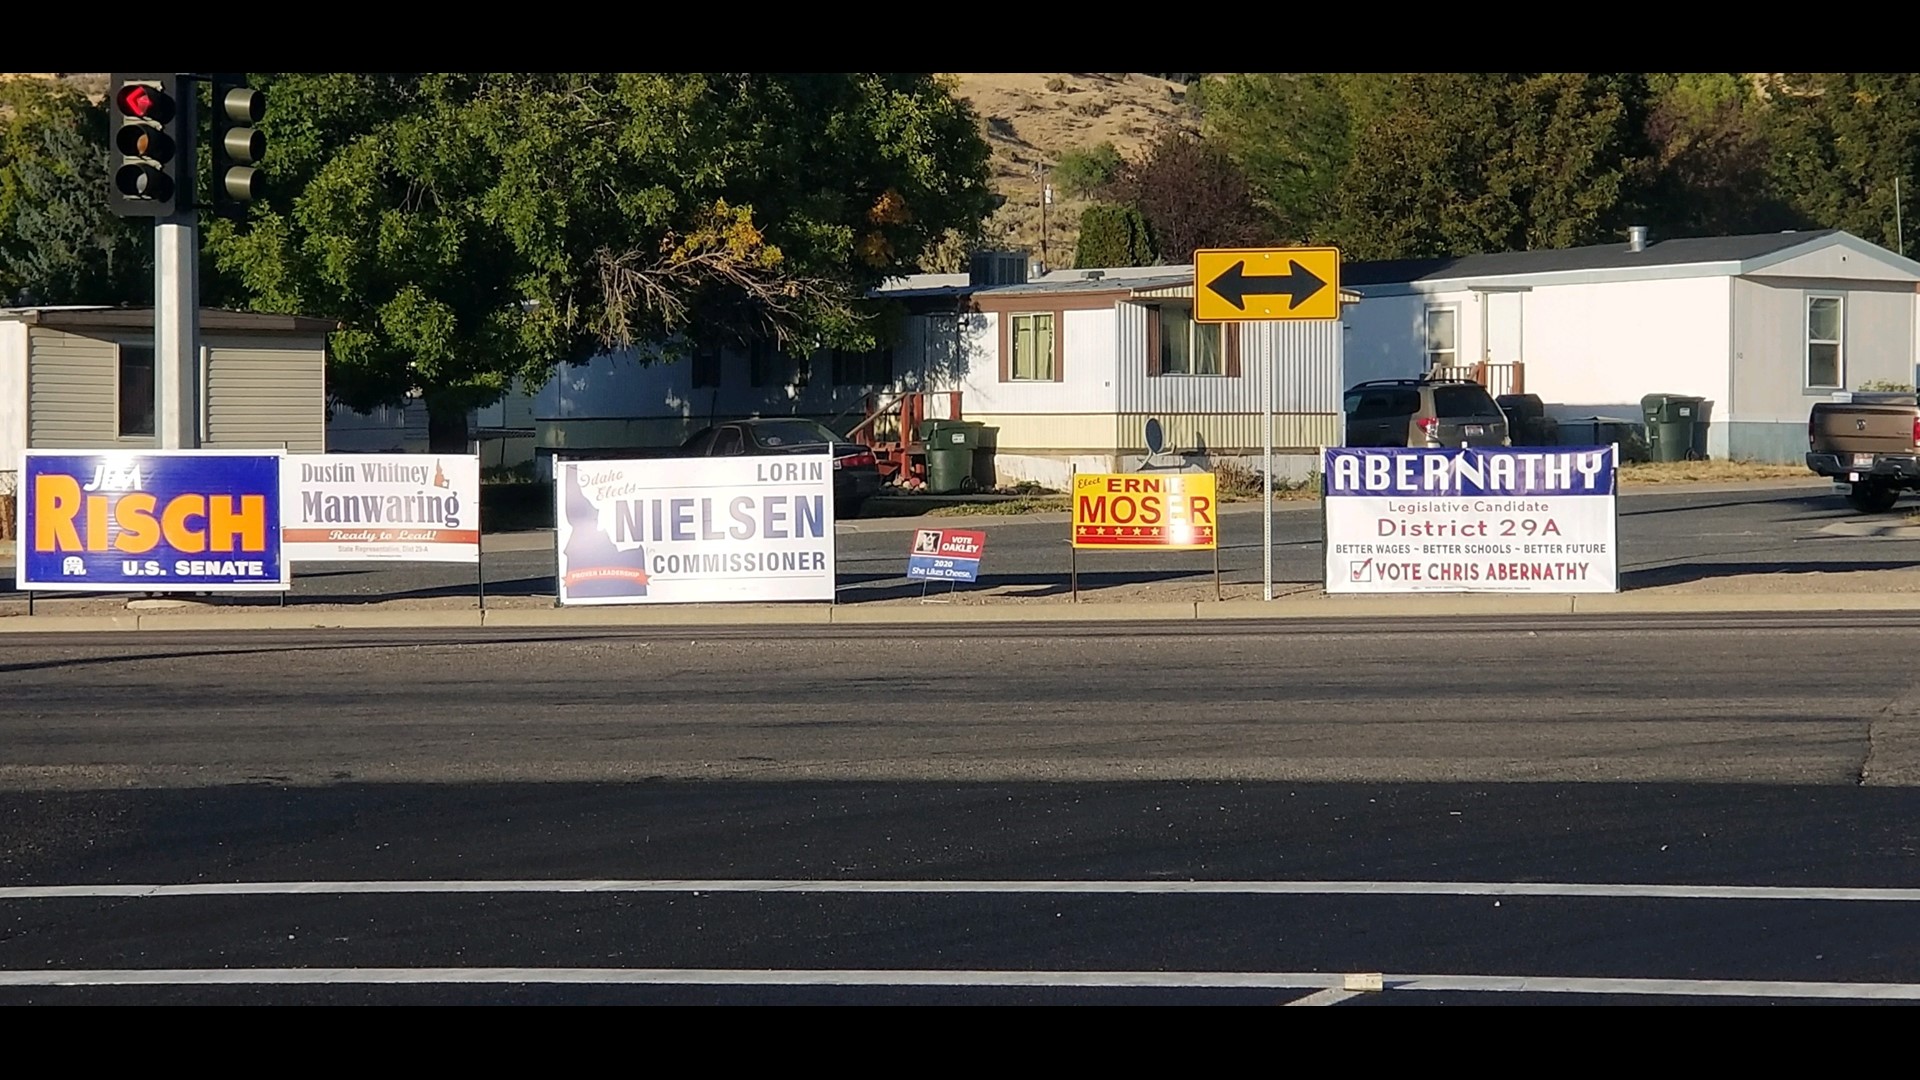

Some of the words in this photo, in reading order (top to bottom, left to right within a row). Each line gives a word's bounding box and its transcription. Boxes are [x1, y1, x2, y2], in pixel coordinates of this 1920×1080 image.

[301, 462, 355, 483] Dustin
[361, 462, 429, 486] Whitney
[580, 468, 624, 488] Idaho
[757, 462, 823, 482] LORIN
[1334, 453, 1602, 491] ABERNATHY
[595, 482, 637, 502] Elects
[1077, 477, 1101, 489] Elect
[35, 474, 265, 553] RISCH
[301, 490, 460, 528] Manwaring
[1388, 501, 1470, 515] Legislative
[1474, 500, 1549, 513] Candidate
[615, 495, 824, 543] NIELSEN
[1378, 518, 1488, 537] District
[1499, 518, 1562, 537] 29A
[328, 529, 377, 543] Ready
[379, 531, 392, 540] to
[397, 530, 437, 541] Lead!
[951, 536, 973, 545] VOTE
[942, 543, 979, 554] OAKLEY
[1336, 544, 1374, 554] BETTER
[1376, 544, 1411, 554] WAGES
[1423, 544, 1462, 554] BETTER
[1465, 544, 1512, 554] SCHOOLS
[1524, 544, 1563, 554] BETTER
[1566, 544, 1606, 554] FUTURE
[122, 560, 167, 576] U.S.
[175, 560, 263, 576] SENATE
[653, 552, 825, 574] COMMISSIONER
[934, 559, 953, 568] 2020
[1376, 562, 1422, 581] VOTE
[1427, 562, 1480, 581] CHRIS
[1485, 562, 1589, 581] ABERNATHY
[572, 570, 598, 579] PROVEN
[599, 569, 640, 578] LEADERSHIP
[911, 567, 926, 575] She
[926, 567, 944, 576] Likes
[945, 569, 972, 579] Cheese.
